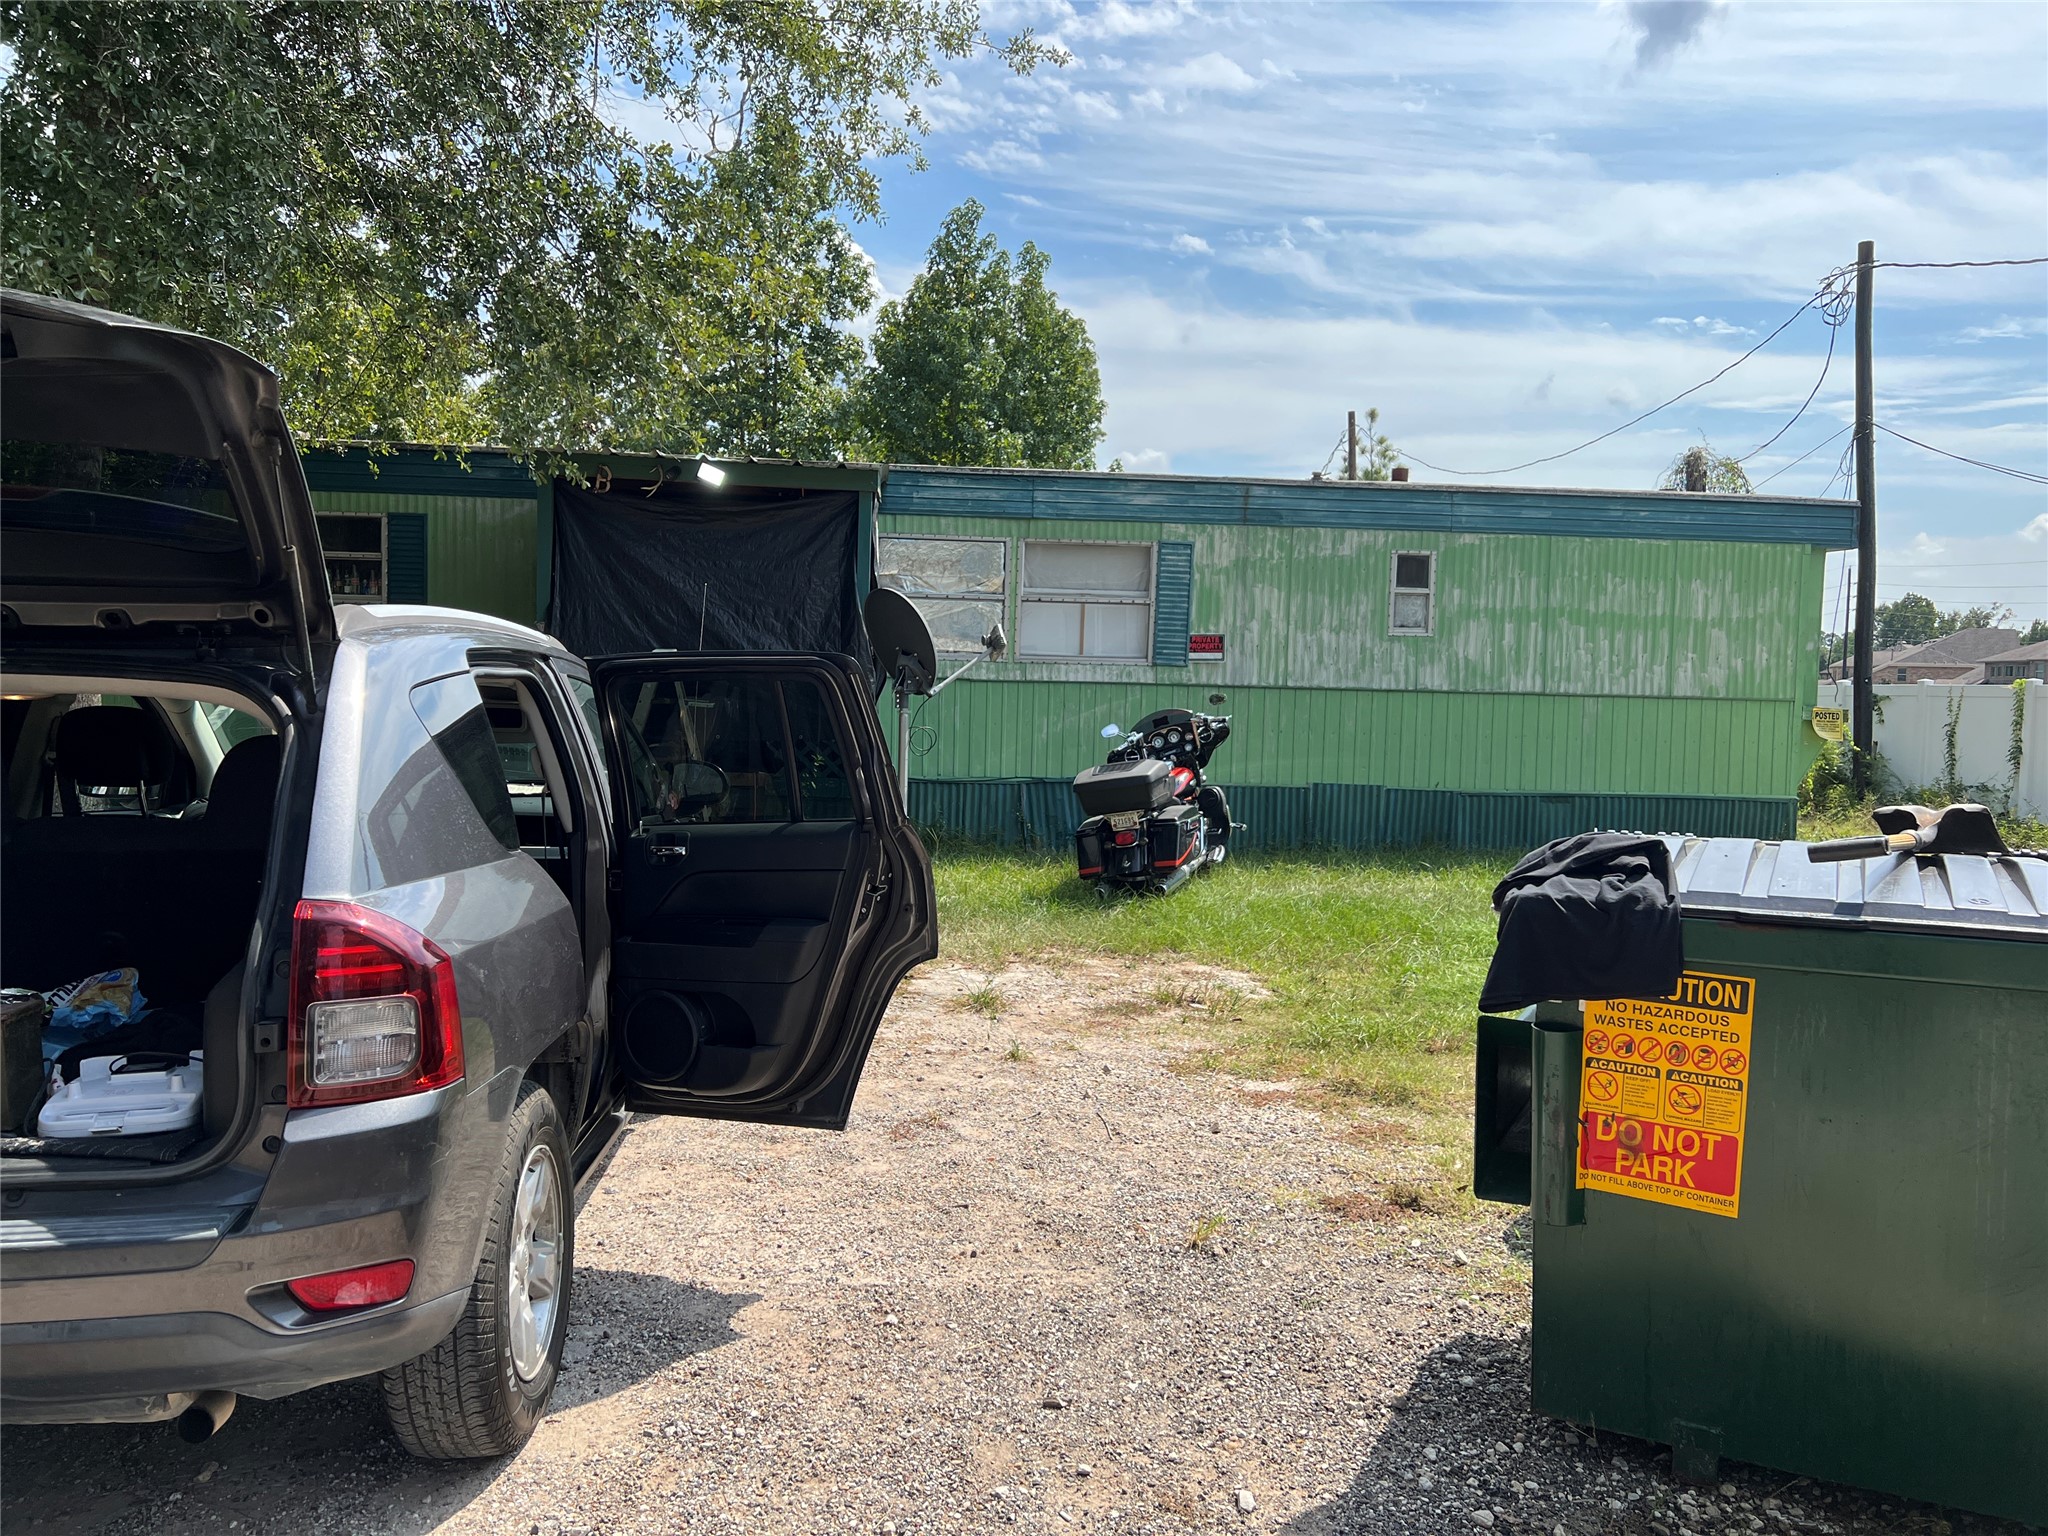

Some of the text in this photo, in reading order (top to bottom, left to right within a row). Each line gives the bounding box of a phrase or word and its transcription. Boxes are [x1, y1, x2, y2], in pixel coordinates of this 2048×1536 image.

[1815, 712, 1840, 720] POSTED
[1660, 977, 1742, 1009] UTION
[1594, 1014, 1740, 1044] WASTES ACCEPTED
[1605, 1001, 1730, 1027] NO HAZARDOUS
[1599, 1060, 1656, 1077] CAUTION
[1680, 1073, 1739, 1089] CAUTION
[1596, 1114, 1722, 1161] DO NOT
[1615, 1147, 1696, 1188] PARK
[1579, 1172, 1735, 1208] DO NOT FILL ABOVE TOP OF CONTAINER
